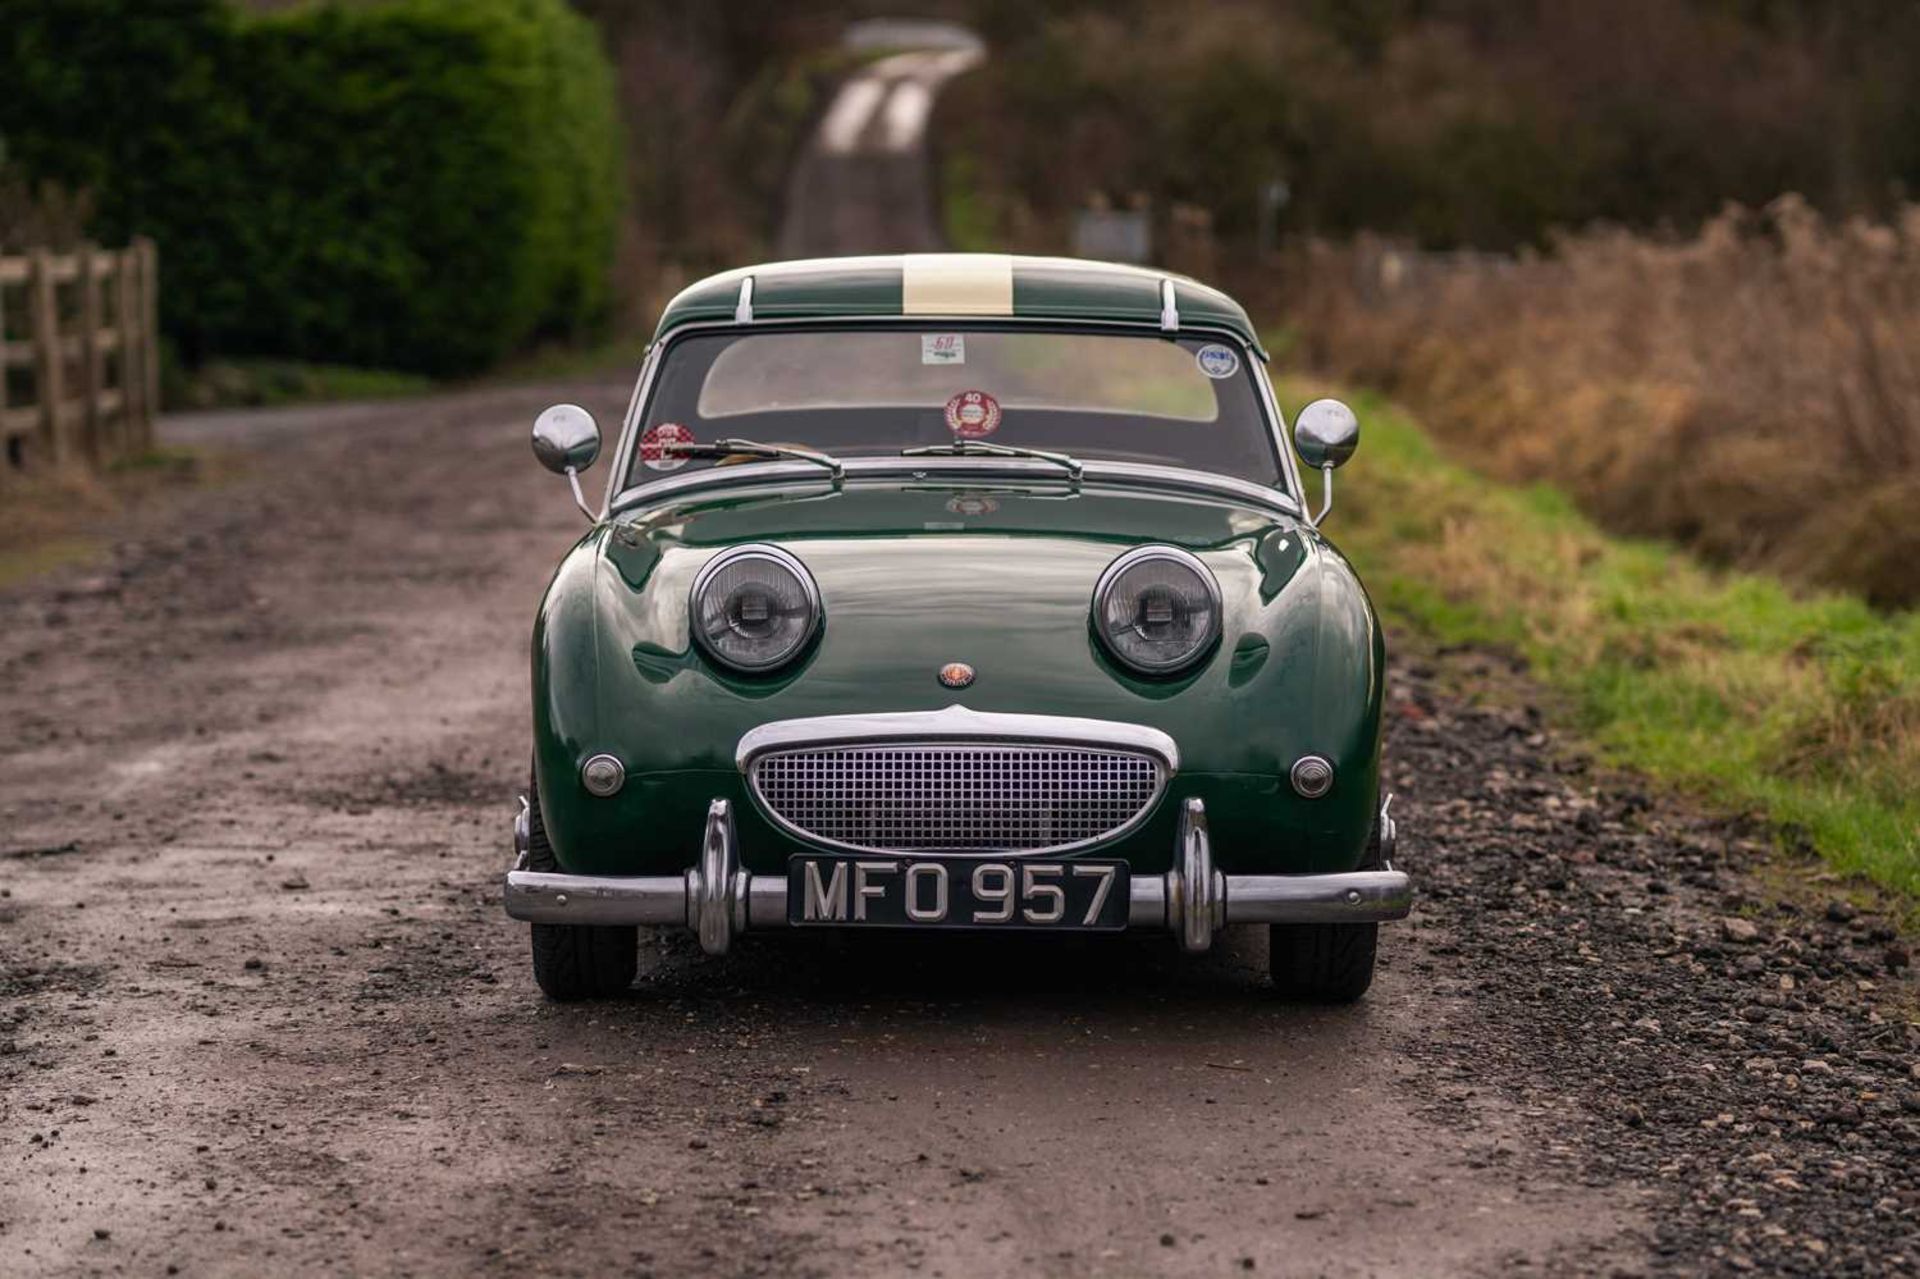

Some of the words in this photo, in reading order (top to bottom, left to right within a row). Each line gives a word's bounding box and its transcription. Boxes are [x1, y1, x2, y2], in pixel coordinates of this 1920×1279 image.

[965, 392, 982, 403] 40
[804, 860, 949, 923] MFO
[972, 863, 1116, 926] 957
